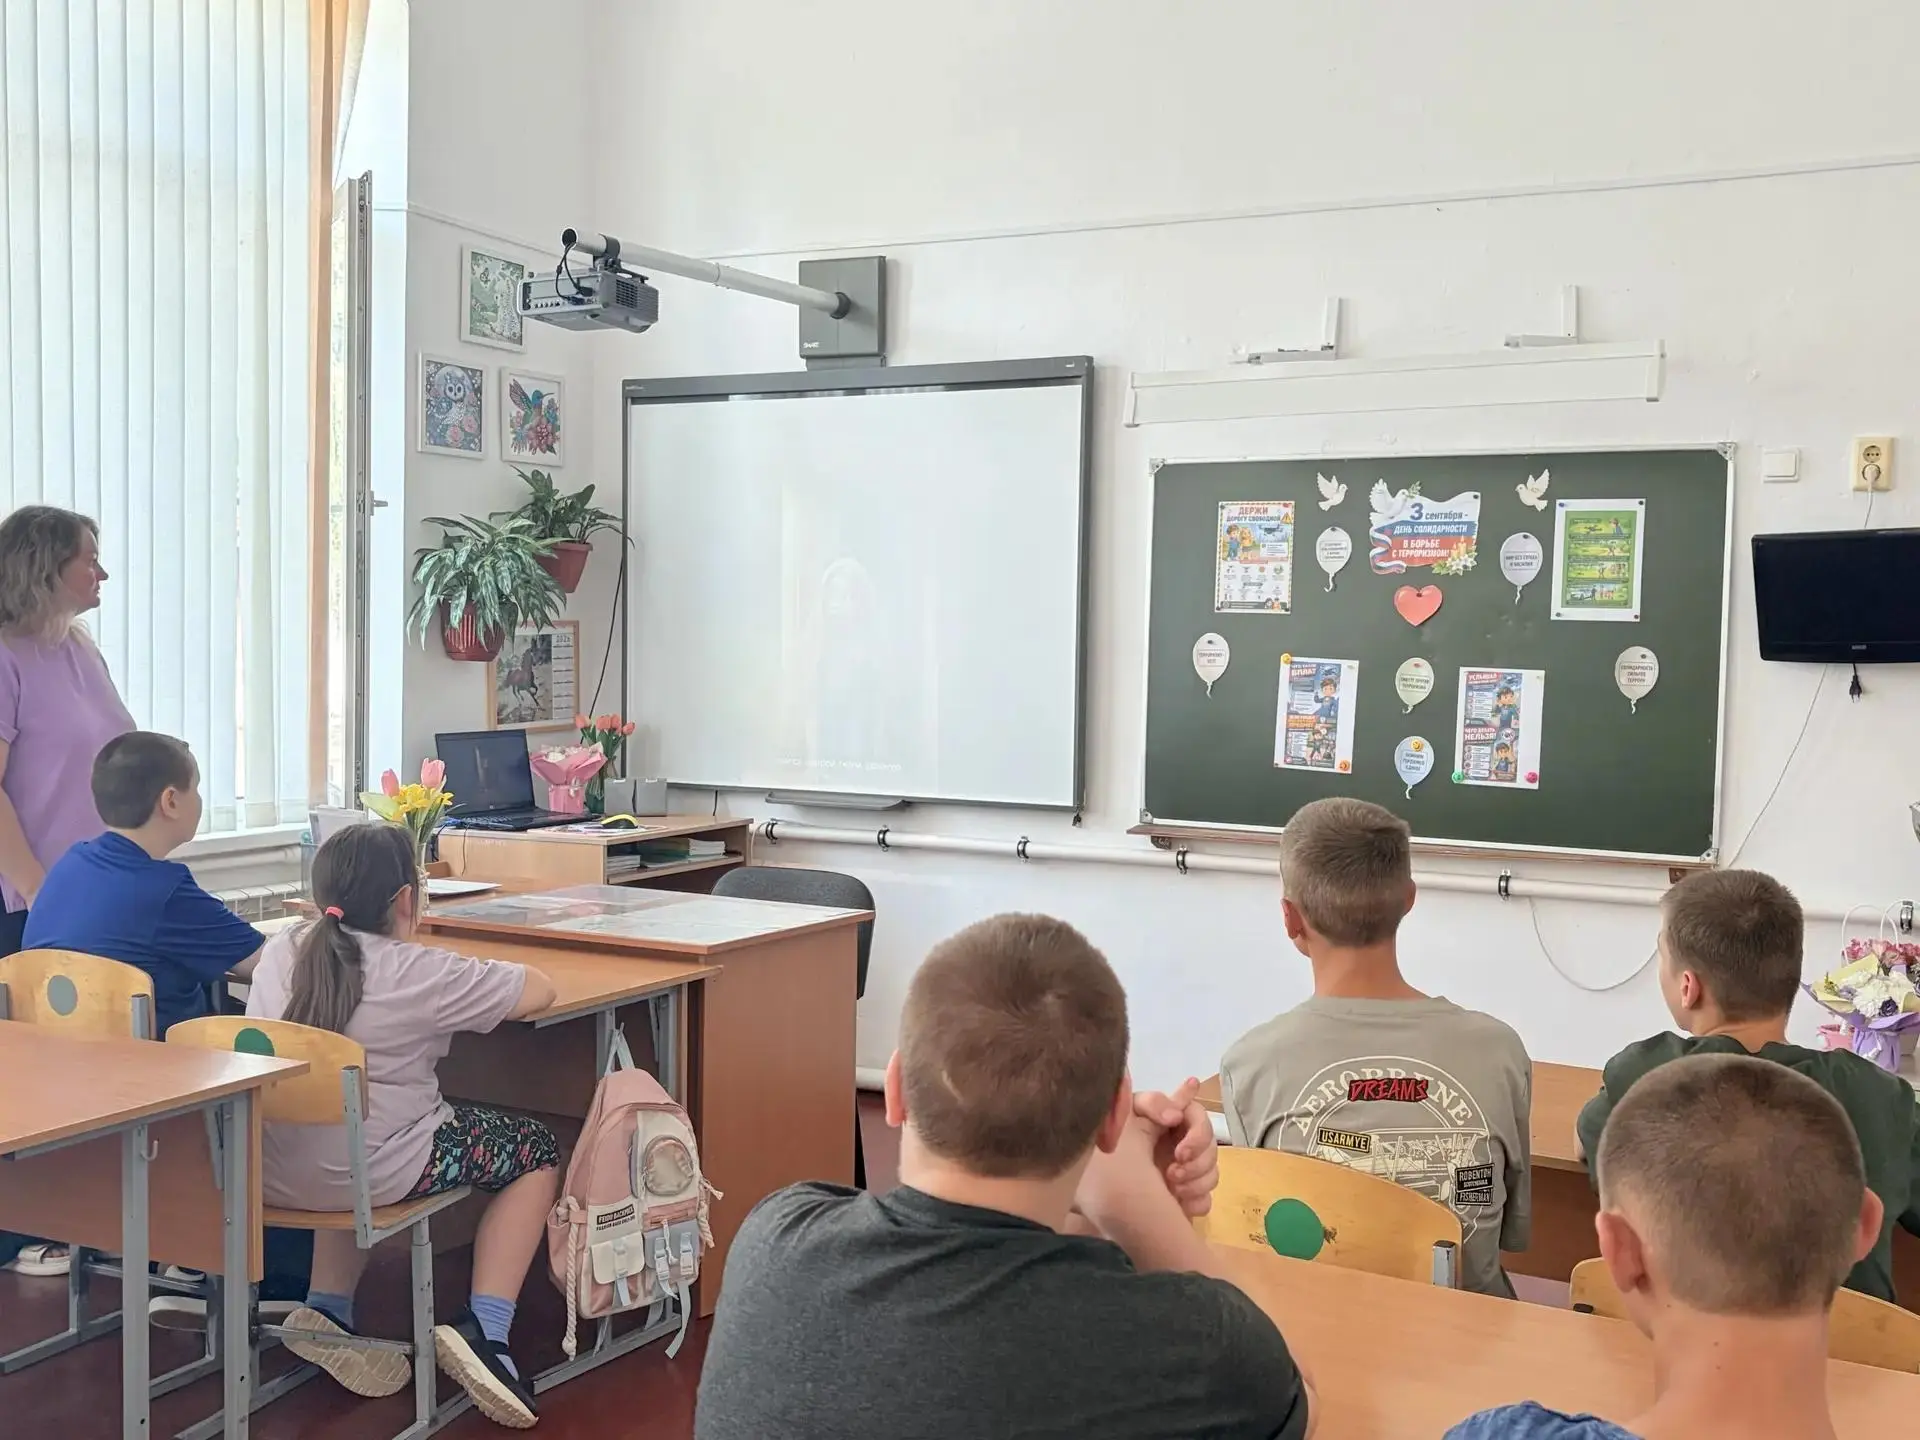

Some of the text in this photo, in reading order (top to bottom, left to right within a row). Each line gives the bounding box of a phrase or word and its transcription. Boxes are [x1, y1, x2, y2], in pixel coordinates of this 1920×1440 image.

[1239, 506, 1269, 515] ДЕРЖИ
[1410, 502, 1424, 521] 3
[1424, 510, 1463, 521] сентября
[1393, 524, 1468, 534] ДЕНЬ СОЛИДАРНОСТИ
[1403, 539, 1441, 549] В БОРЬБЕ
[1391, 549, 1450, 558] С ТЕРРОРИЗМОМ!
[1350, 1079, 1428, 1101] DREAMS
[1321, 1129, 1368, 1150] USARMYE
